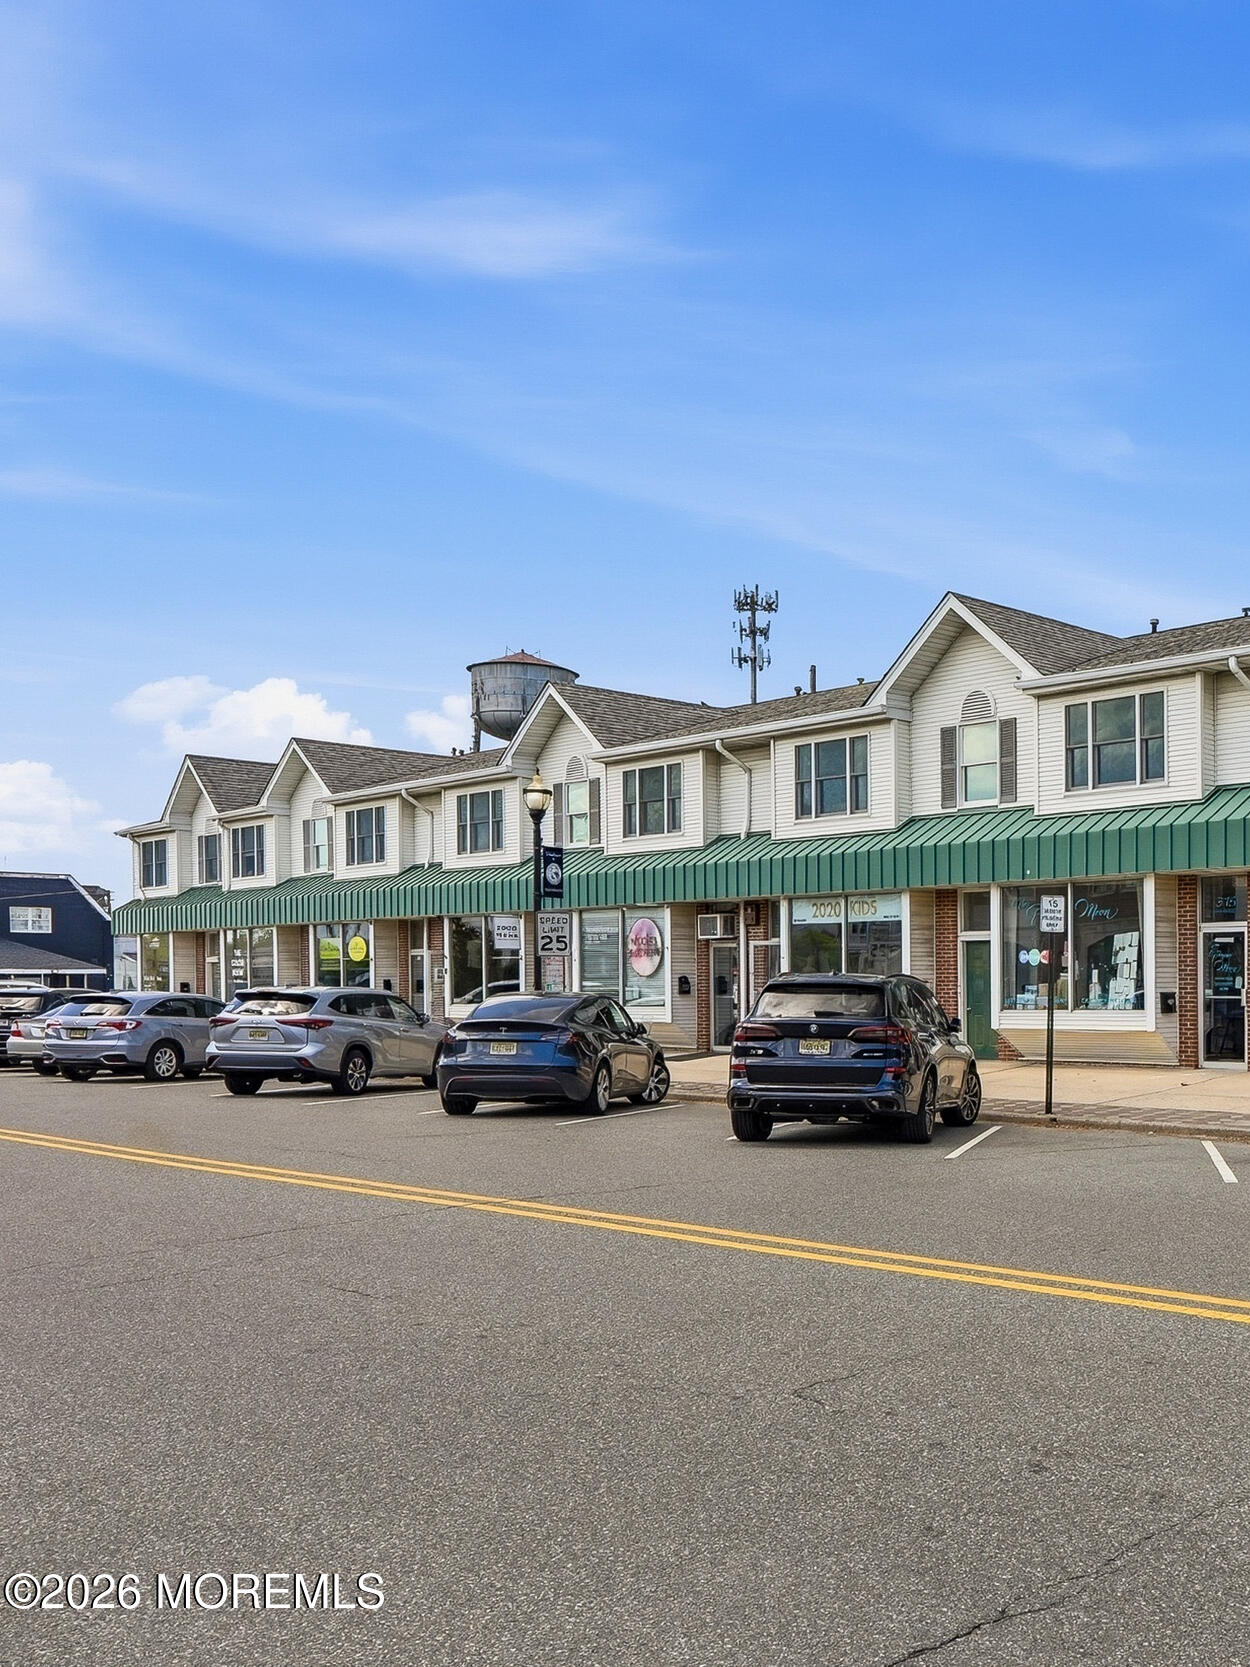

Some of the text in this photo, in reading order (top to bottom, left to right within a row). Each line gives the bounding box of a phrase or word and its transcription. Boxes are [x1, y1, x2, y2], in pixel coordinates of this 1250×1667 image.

[811, 900, 877, 918] 2020 KIDS
[1048, 900, 1058, 908] 15
[1075, 898, 1118, 920] Moon
[539, 917, 568, 925] SPEED
[542, 926, 565, 934] LIMIT
[541, 935, 568, 951] 25
